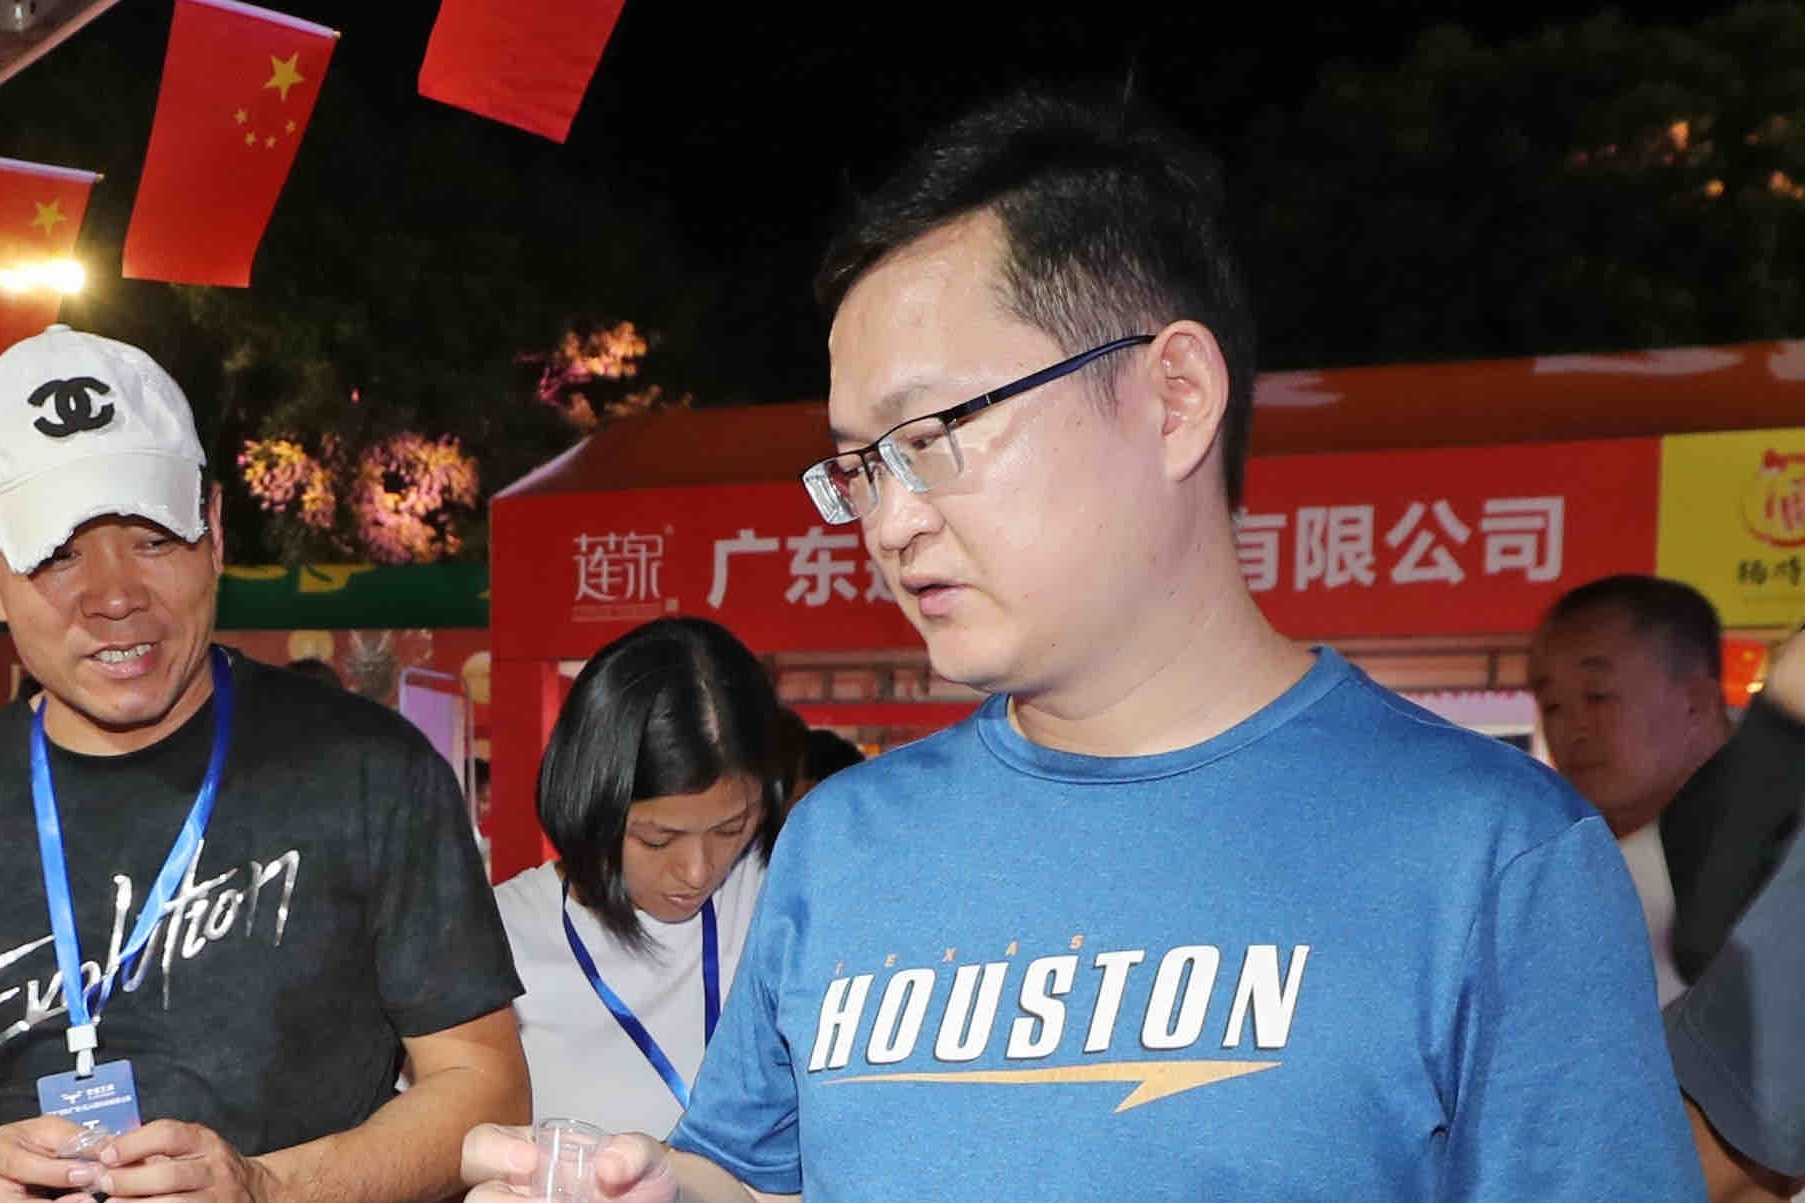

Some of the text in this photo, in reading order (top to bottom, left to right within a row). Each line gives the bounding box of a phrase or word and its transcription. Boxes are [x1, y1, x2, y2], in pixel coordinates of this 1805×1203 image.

[1234, 496, 1565, 593] 有限公司
[807, 943, 1311, 1074] HOUSTON
